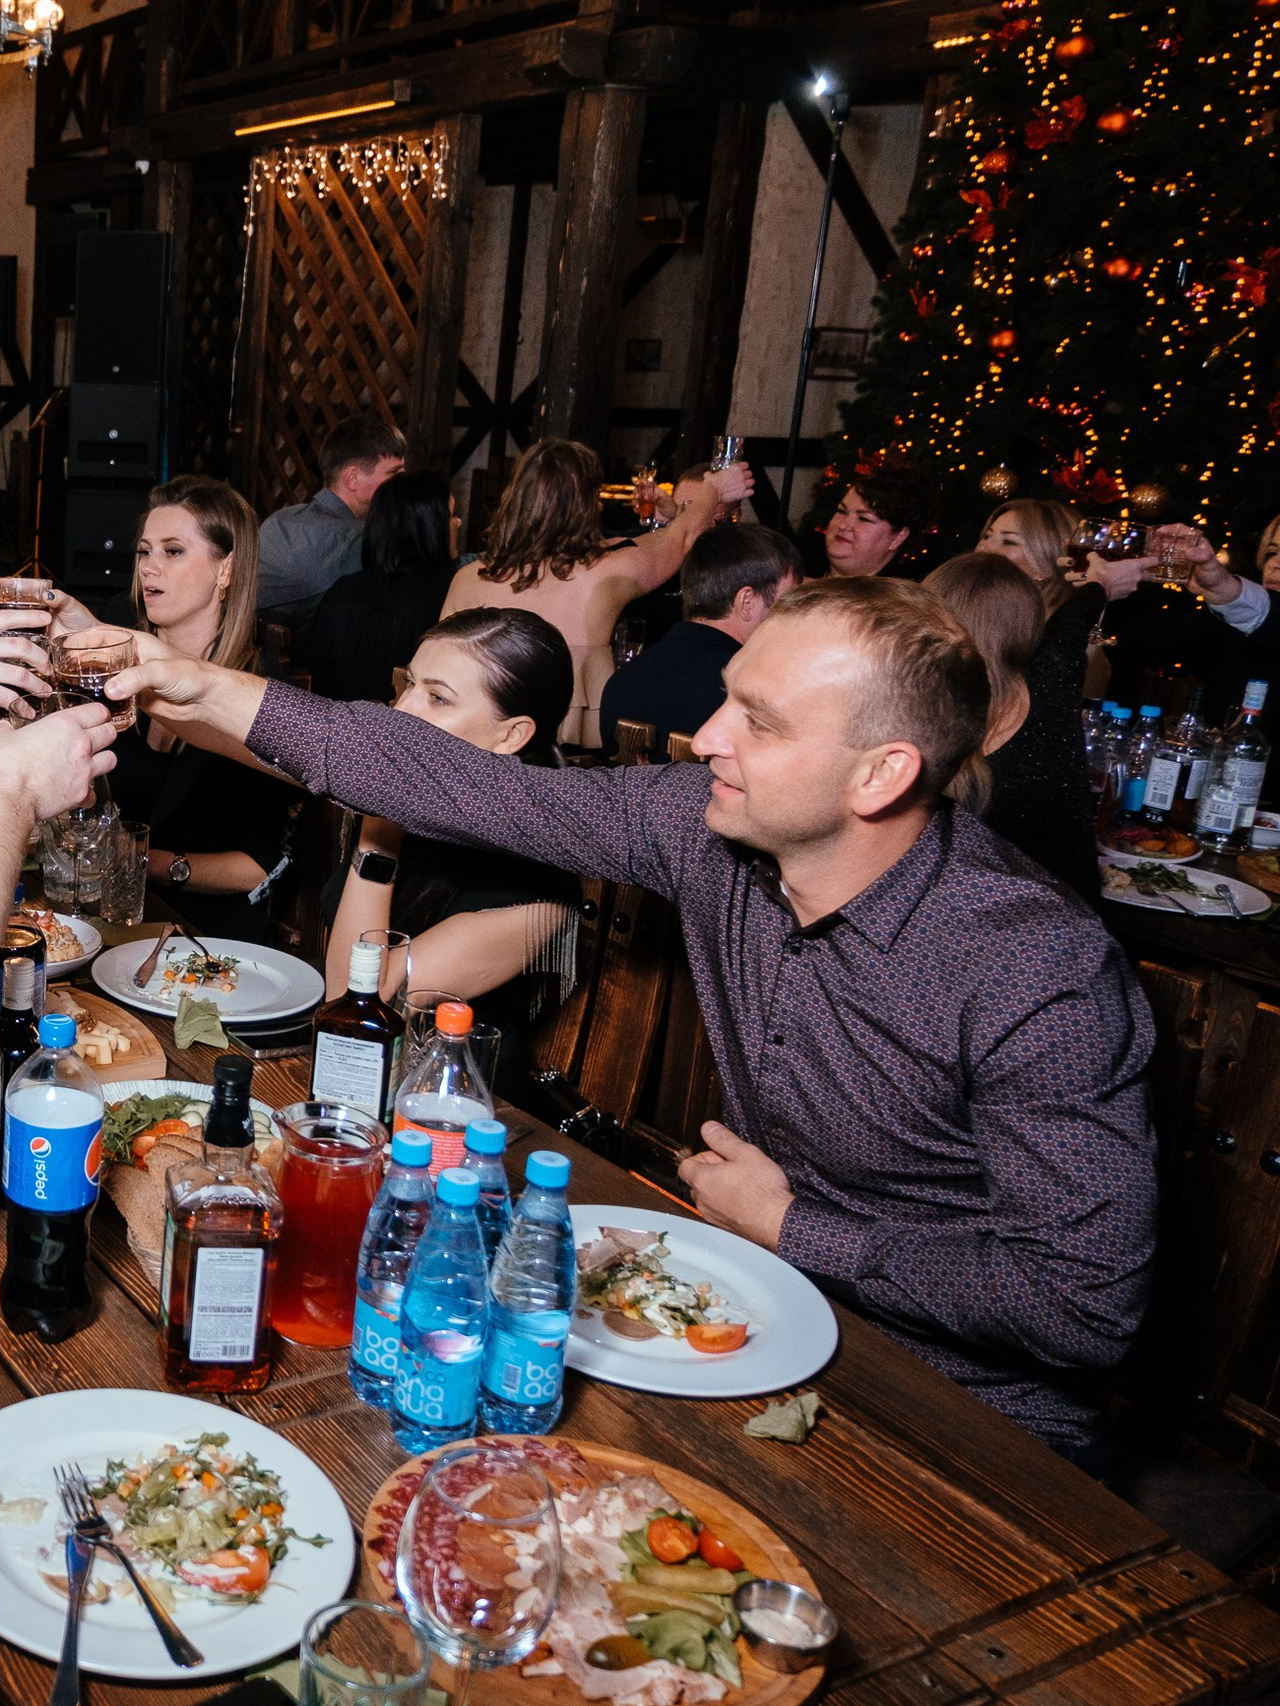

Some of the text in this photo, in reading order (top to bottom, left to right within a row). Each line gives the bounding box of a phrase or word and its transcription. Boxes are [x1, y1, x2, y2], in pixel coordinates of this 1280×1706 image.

[33, 1159, 49, 1200] pepsi
[366, 1325, 400, 1354] bo
[364, 1347, 398, 1375] aq
[526, 1360, 561, 1382] bo
[397, 1368, 444, 1402] ona
[395, 1386, 443, 1420] qua
